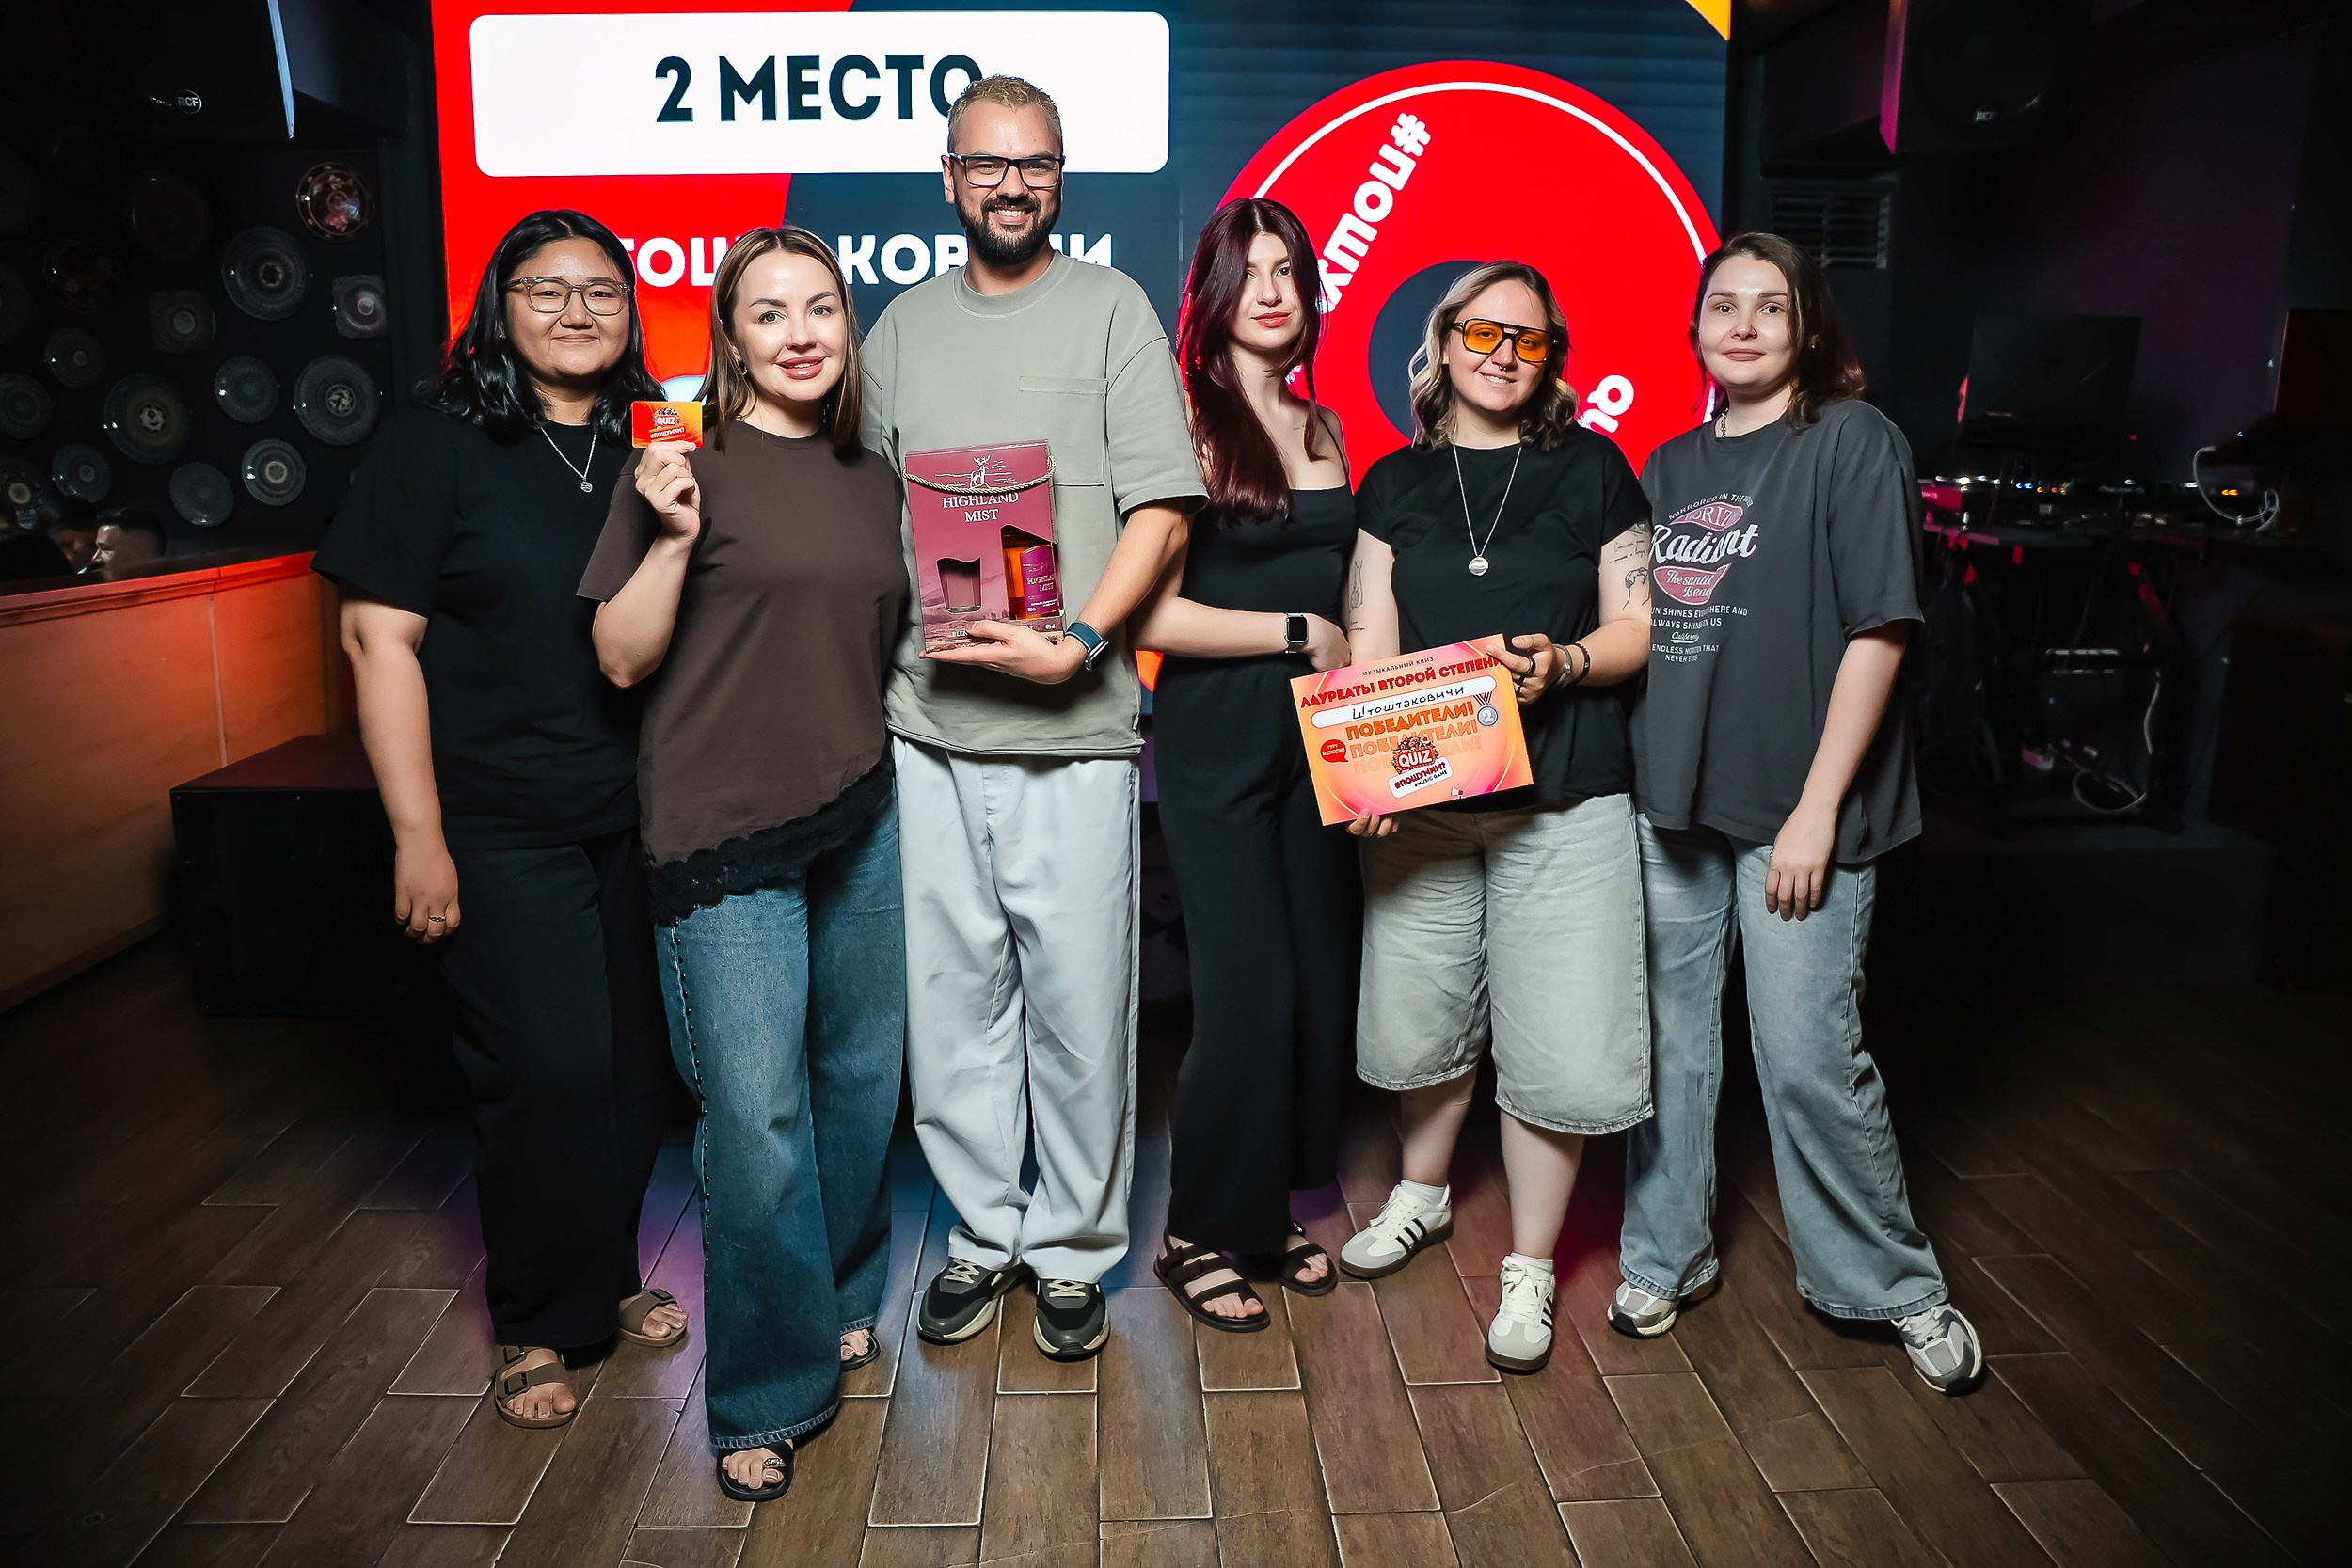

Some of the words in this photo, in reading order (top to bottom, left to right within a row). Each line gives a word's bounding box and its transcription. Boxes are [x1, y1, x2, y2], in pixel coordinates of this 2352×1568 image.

[655, 56, 693, 122] 2
[719, 54, 983, 122] МЕСТО
[178, 97, 199, 106] RCF
[656, 417, 676, 425] QUIZ
[942, 492, 1019, 508] HIGHLAND
[1668, 496, 1717, 520] MIRRORED
[964, 509, 998, 522] MIST
[1666, 570, 1683, 585] The
[1662, 607, 1692, 618] SHINES
[1732, 606, 1748, 616] AND
[1710, 618, 1722, 626] US
[1652, 643, 1683, 655] ENDLESS
[1664, 654, 1689, 662] NEVER
[1300, 682, 1375, 709] ЛАУРЕАТЫ
[1378, 666, 1437, 691] ВТОРОЙ
[1345, 700, 1474, 741] ПОБЕДИТЕЛИ!
[1482, 708, 1494, 723] 2
[1398, 749, 1434, 768] QUIZ
[1433, 770, 1448, 781] GAME
